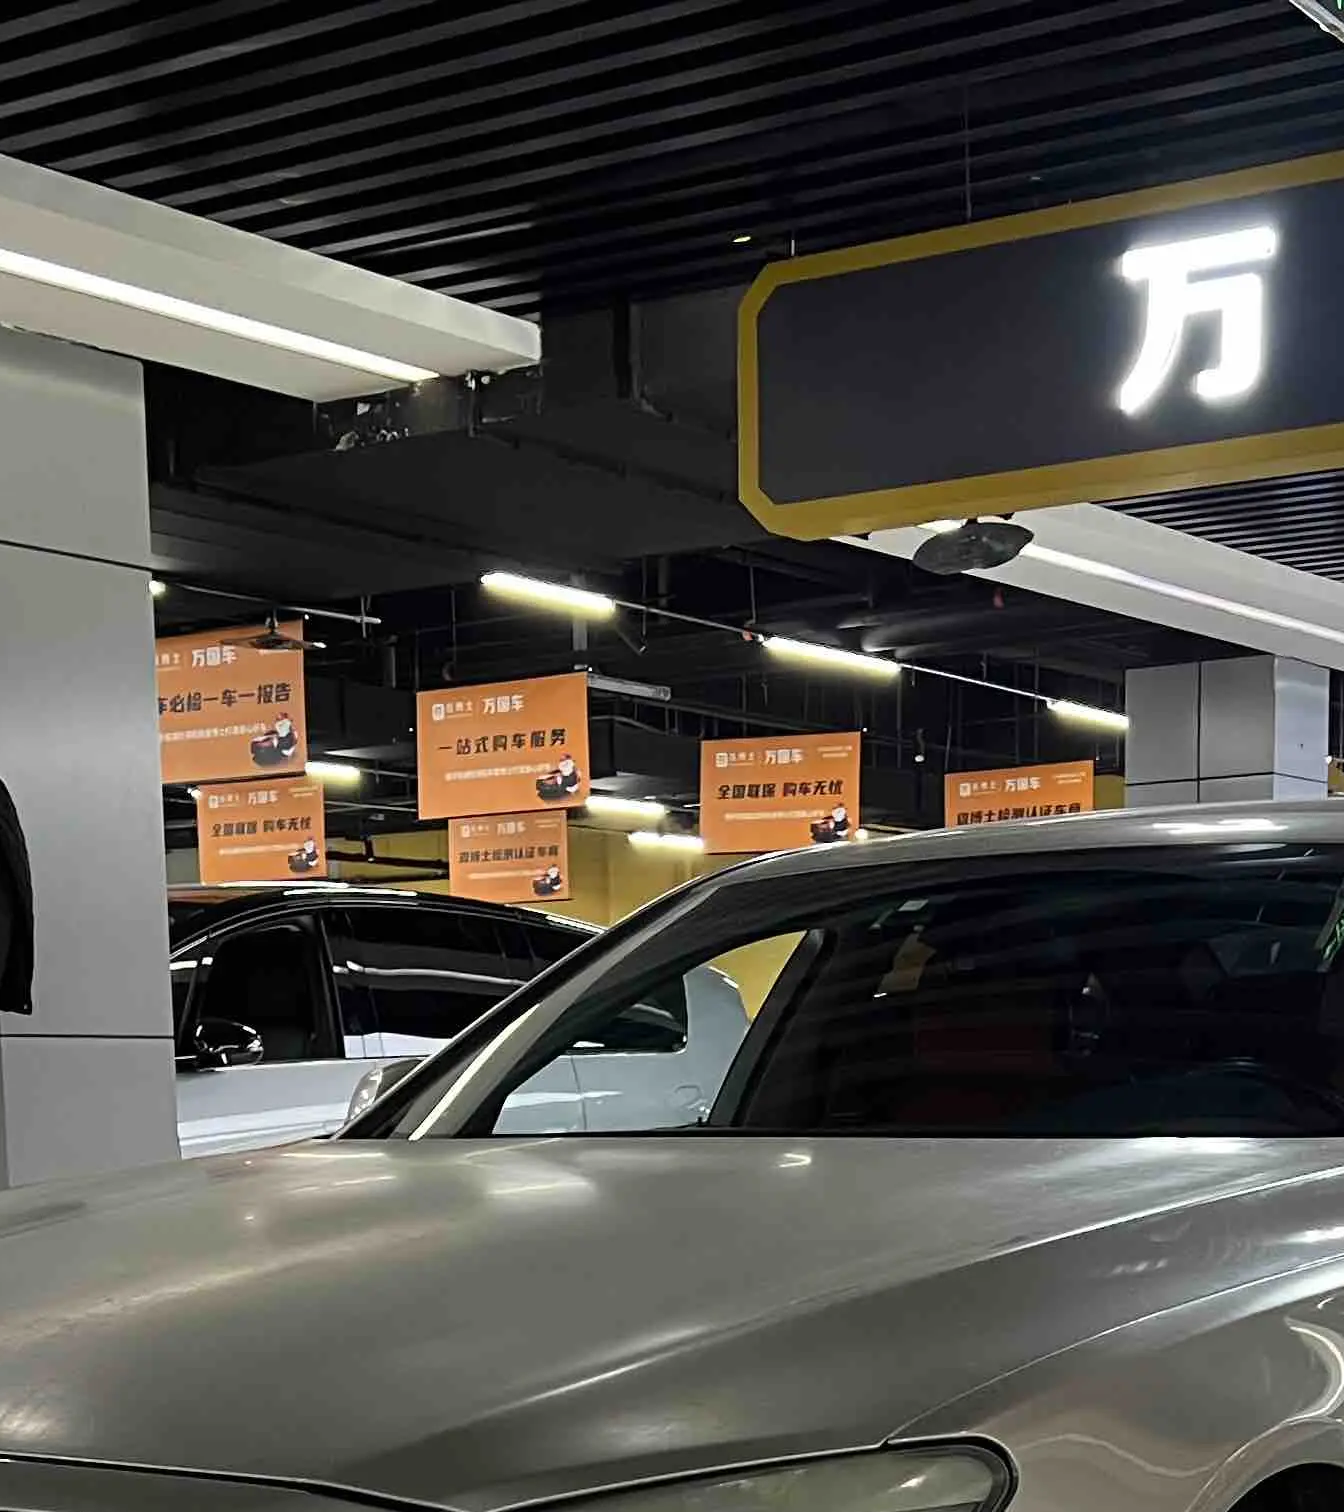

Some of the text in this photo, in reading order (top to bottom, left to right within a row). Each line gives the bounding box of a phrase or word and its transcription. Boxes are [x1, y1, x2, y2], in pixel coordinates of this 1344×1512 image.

[482, 695, 524, 715] 万国车
[439, 728, 566, 755] 一站式购车服务
